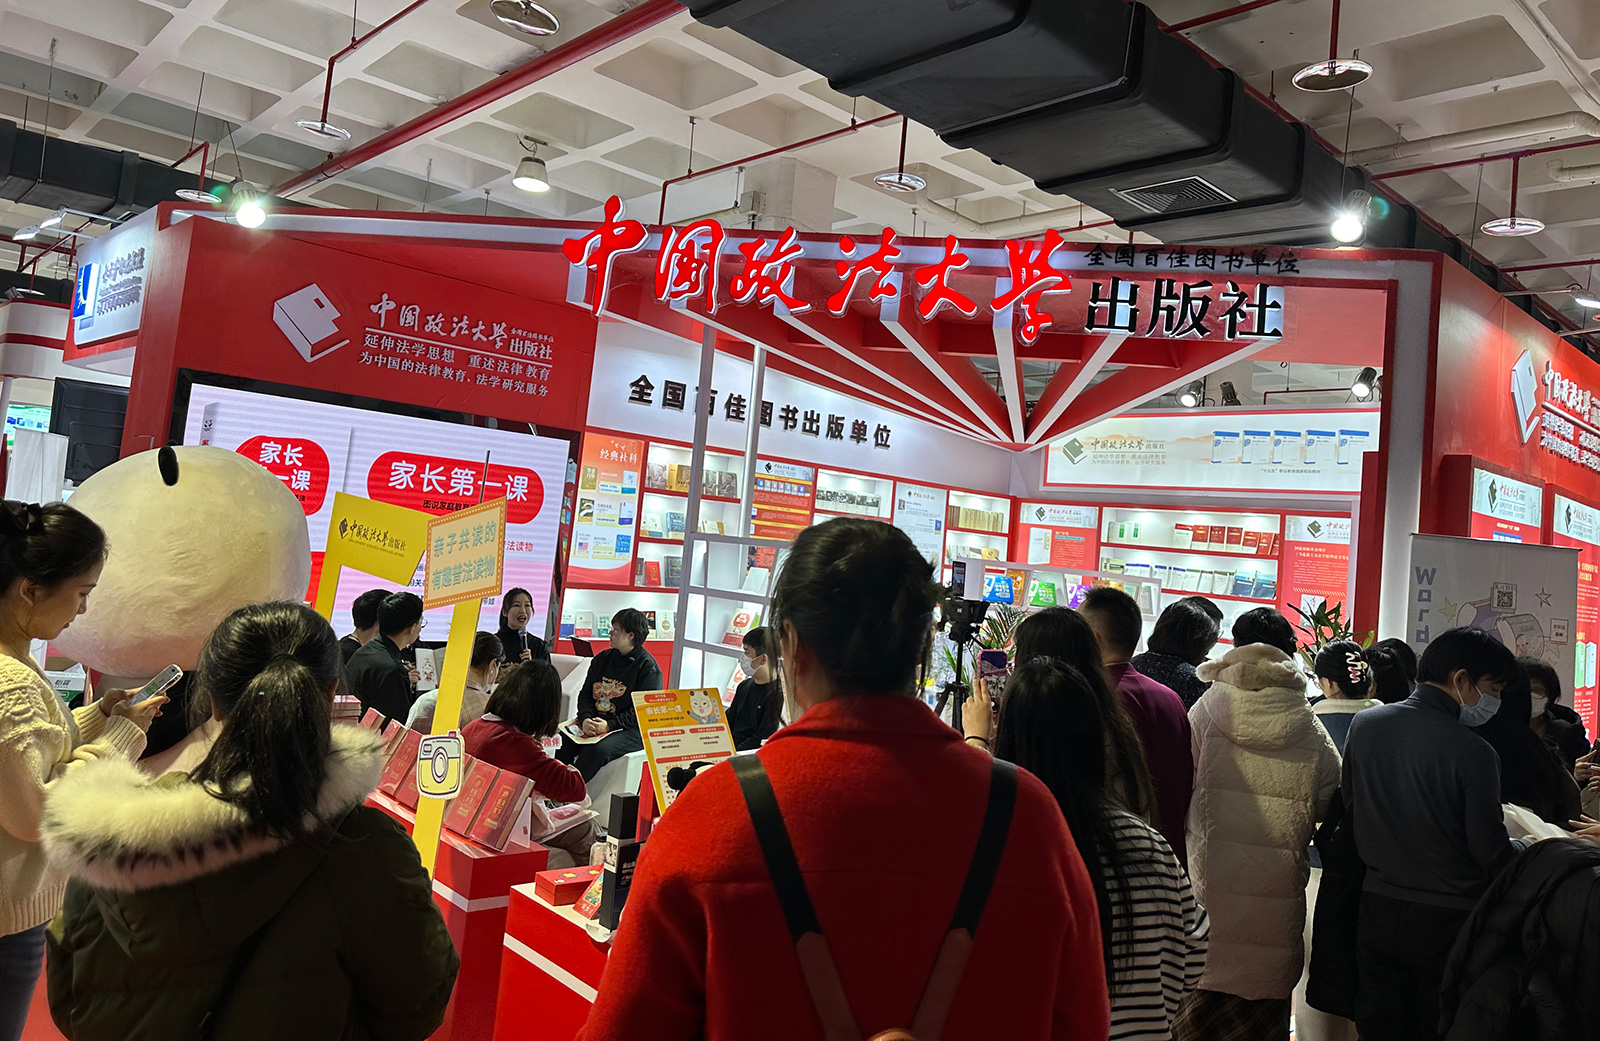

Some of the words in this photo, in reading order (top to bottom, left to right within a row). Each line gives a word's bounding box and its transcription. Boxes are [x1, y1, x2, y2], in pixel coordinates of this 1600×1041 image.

[1084, 243, 1301, 275] 全国百佳图书单位
[1084, 276, 1284, 340] 出版社
[362, 332, 456, 364] 延伸法学思想
[467, 353, 551, 382] 重述法律教育
[508, 337, 553, 361] 出版社
[359, 350, 550, 398] 为中国的法律教育、法学研究服务
[259, 440, 304, 467] 家长
[600, 448, 639, 465] 经典社科
[387, 459, 530, 503] 家长第一课
[433, 520, 498, 558] 亲子共读的
[430, 554, 497, 591] 有趣普法读物
